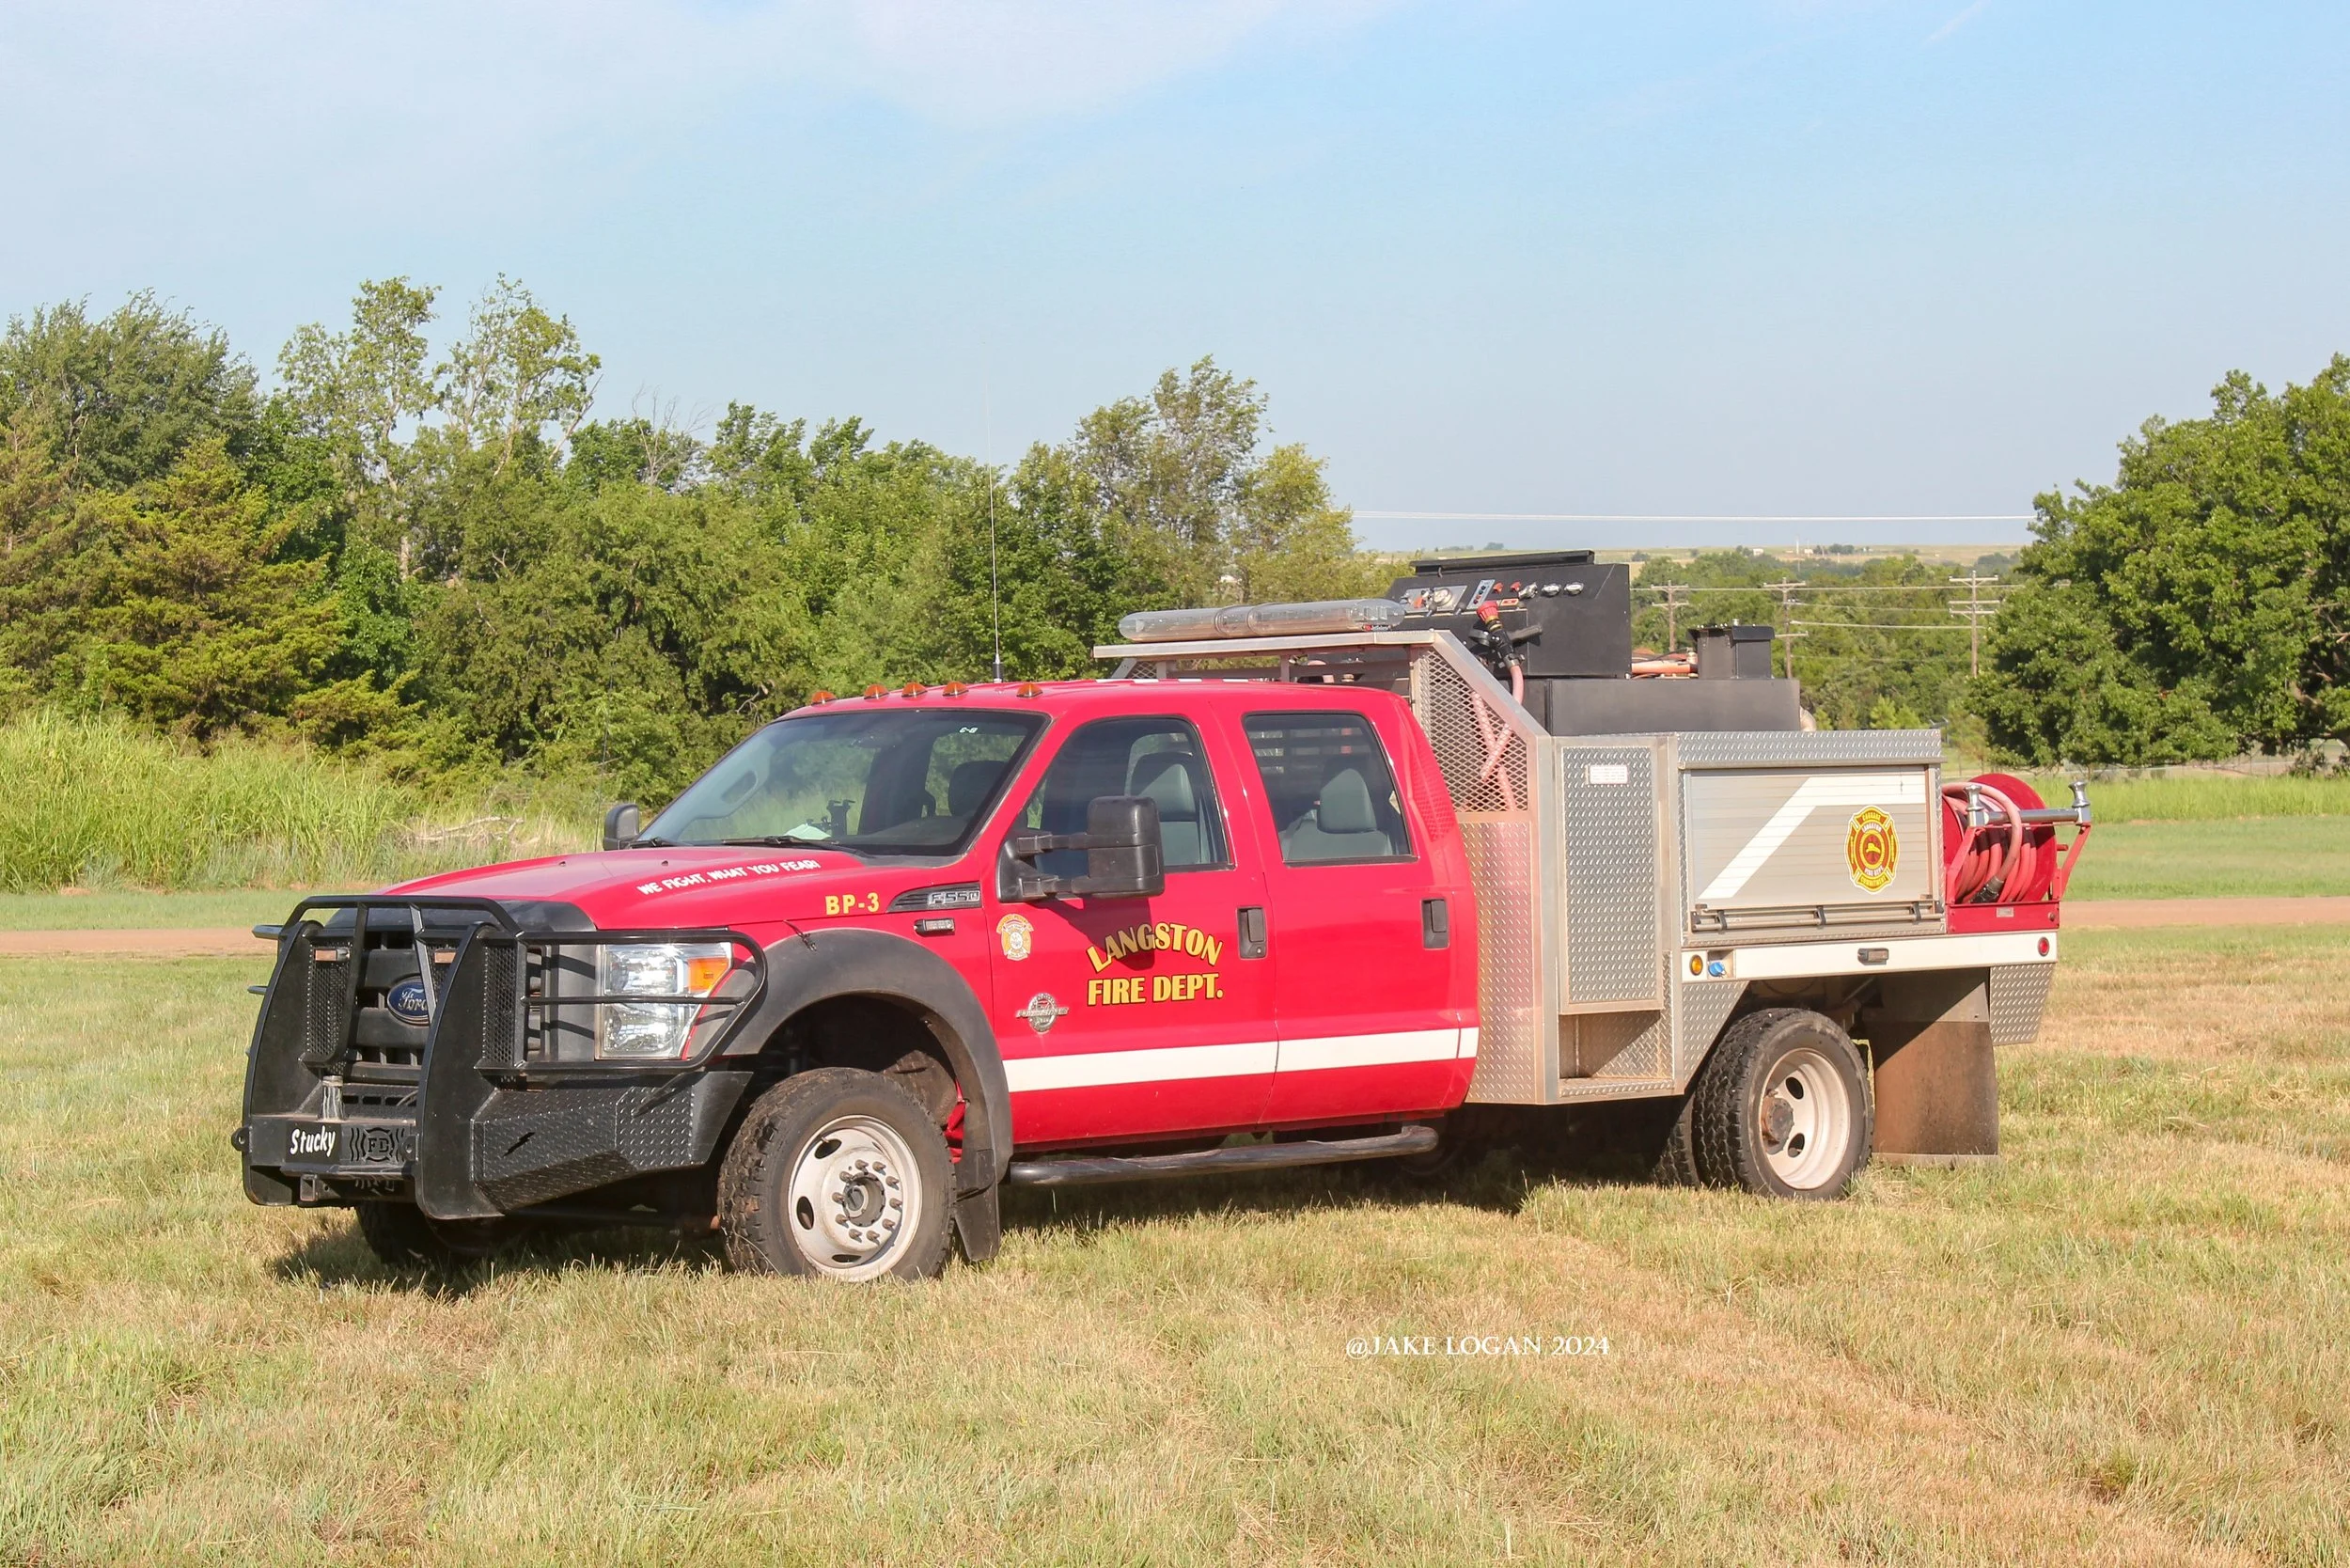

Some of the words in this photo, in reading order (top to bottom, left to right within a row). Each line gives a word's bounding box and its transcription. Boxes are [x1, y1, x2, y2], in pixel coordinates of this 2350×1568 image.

[636, 882, 663, 895] WE
[707, 867, 748, 881] WHAT
[747, 863, 780, 875] YOU
[824, 892, 880, 916] BP-3
[1086, 921, 1223, 974] LANGSTON
[1087, 976, 1146, 1006] FIRE
[1152, 973, 1224, 1003] DEPT.
[290, 1125, 337, 1158] Stucky
